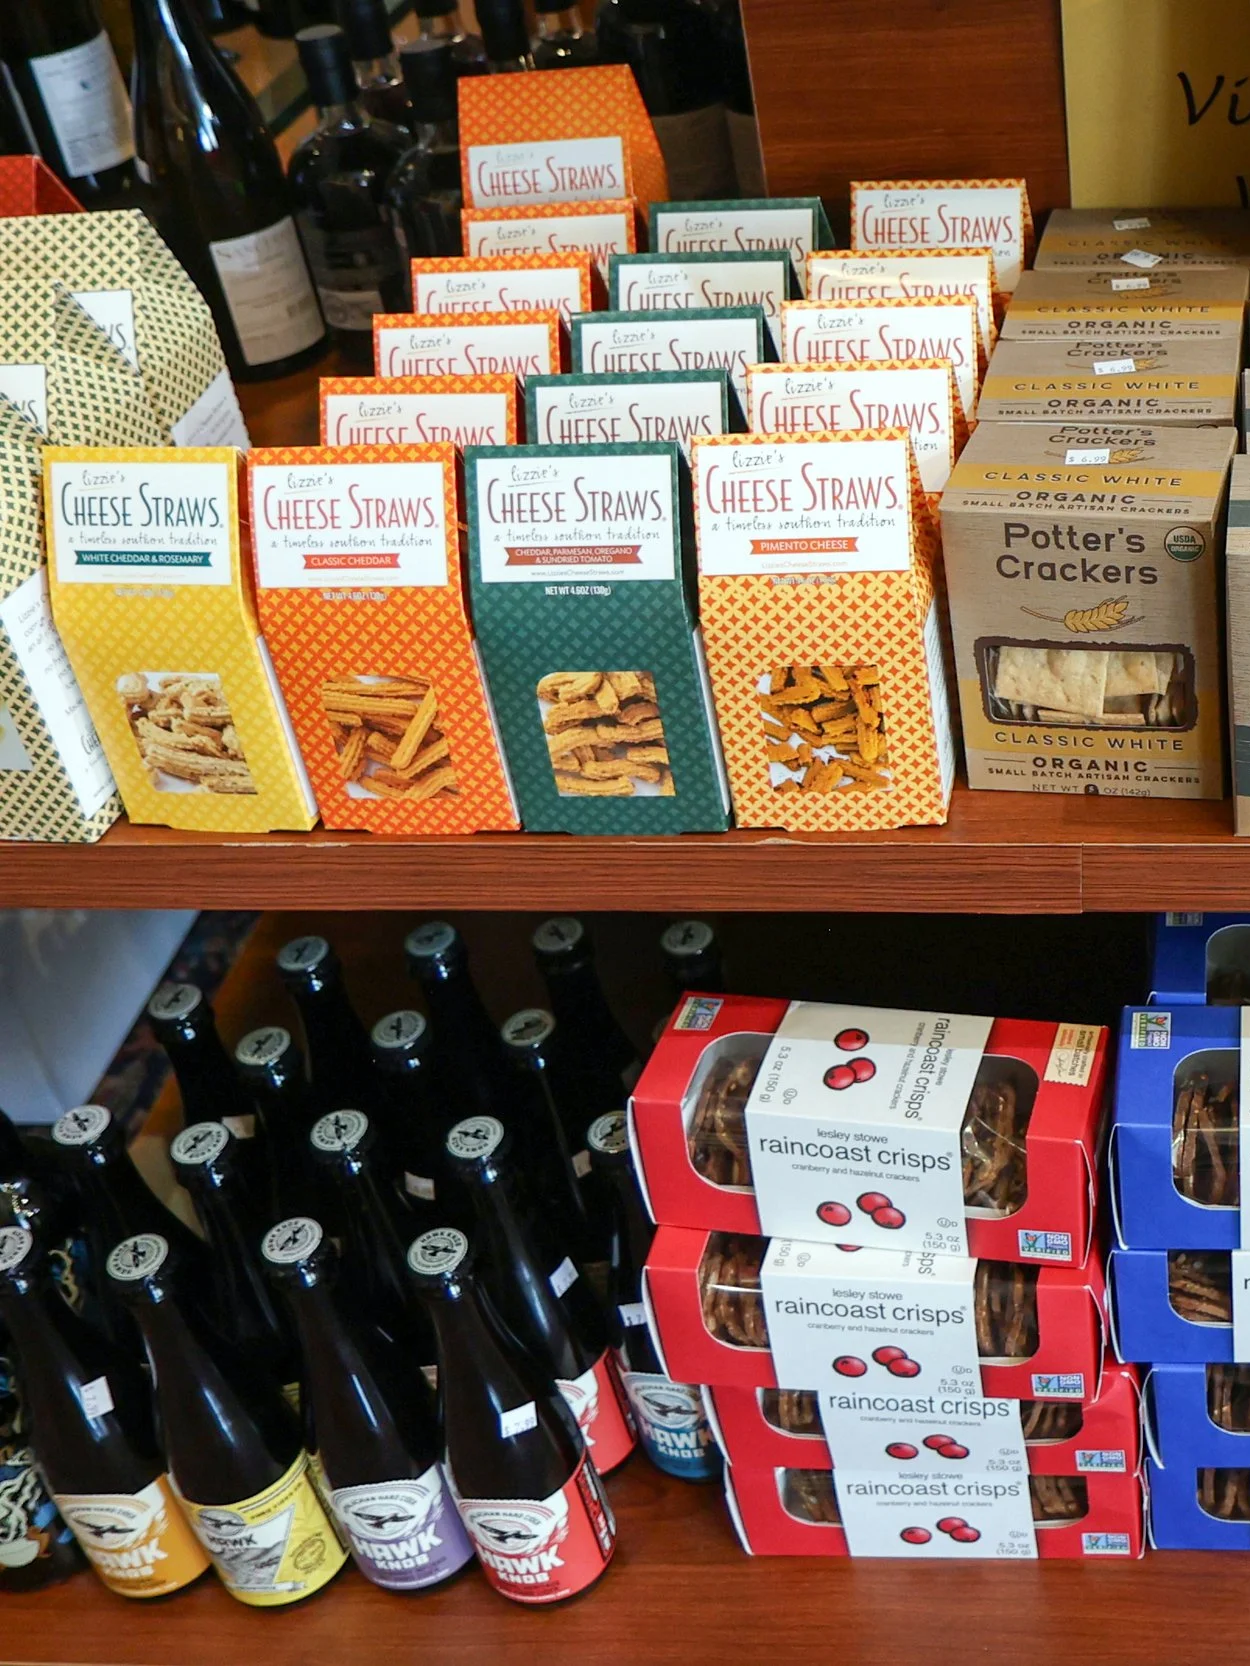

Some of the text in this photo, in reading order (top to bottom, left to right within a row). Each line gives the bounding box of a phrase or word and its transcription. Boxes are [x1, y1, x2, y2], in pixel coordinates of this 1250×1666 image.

[478, 161, 542, 197] CHEESE
[862, 204, 931, 245] CHEESE
[487, 478, 565, 524] CHEESE
[706, 464, 793, 514] CHEESE
[61, 482, 133, 527] CHEESE
[263, 485, 341, 530] CHEESE
[837, 513, 896, 528] tradition
[760, 541, 848, 551] PIMENTO CHEESE
[1004, 522, 1145, 553] Potter's
[82, 554, 109, 563] WHITE
[110, 554, 150, 563] CHEDDAR
[159, 555, 204, 564] ROSEMARY
[311, 556, 391, 566] CLASSIC CHEDDAR
[542, 556, 578, 564] SUNDRIED
[595, 547, 632, 555] OREGANO
[996, 555, 1158, 585] Crackers
[545, 587, 557, 595] NET
[558, 587, 569, 595] WT
[994, 731, 1183, 750] CLASSIC WHITE
[1032, 756, 1148, 773] ORGANIC
[817, 1128, 888, 1144] lesley stowe
[760, 1136, 951, 1173] raincoast crisps
[774, 1297, 965, 1326] raincoast crisps
[351, 1523, 443, 1560] HAWK
[375, 1553, 430, 1571] KNOB
[475, 1545, 565, 1574] HAWK
[497, 1570, 550, 1584] KNOB
